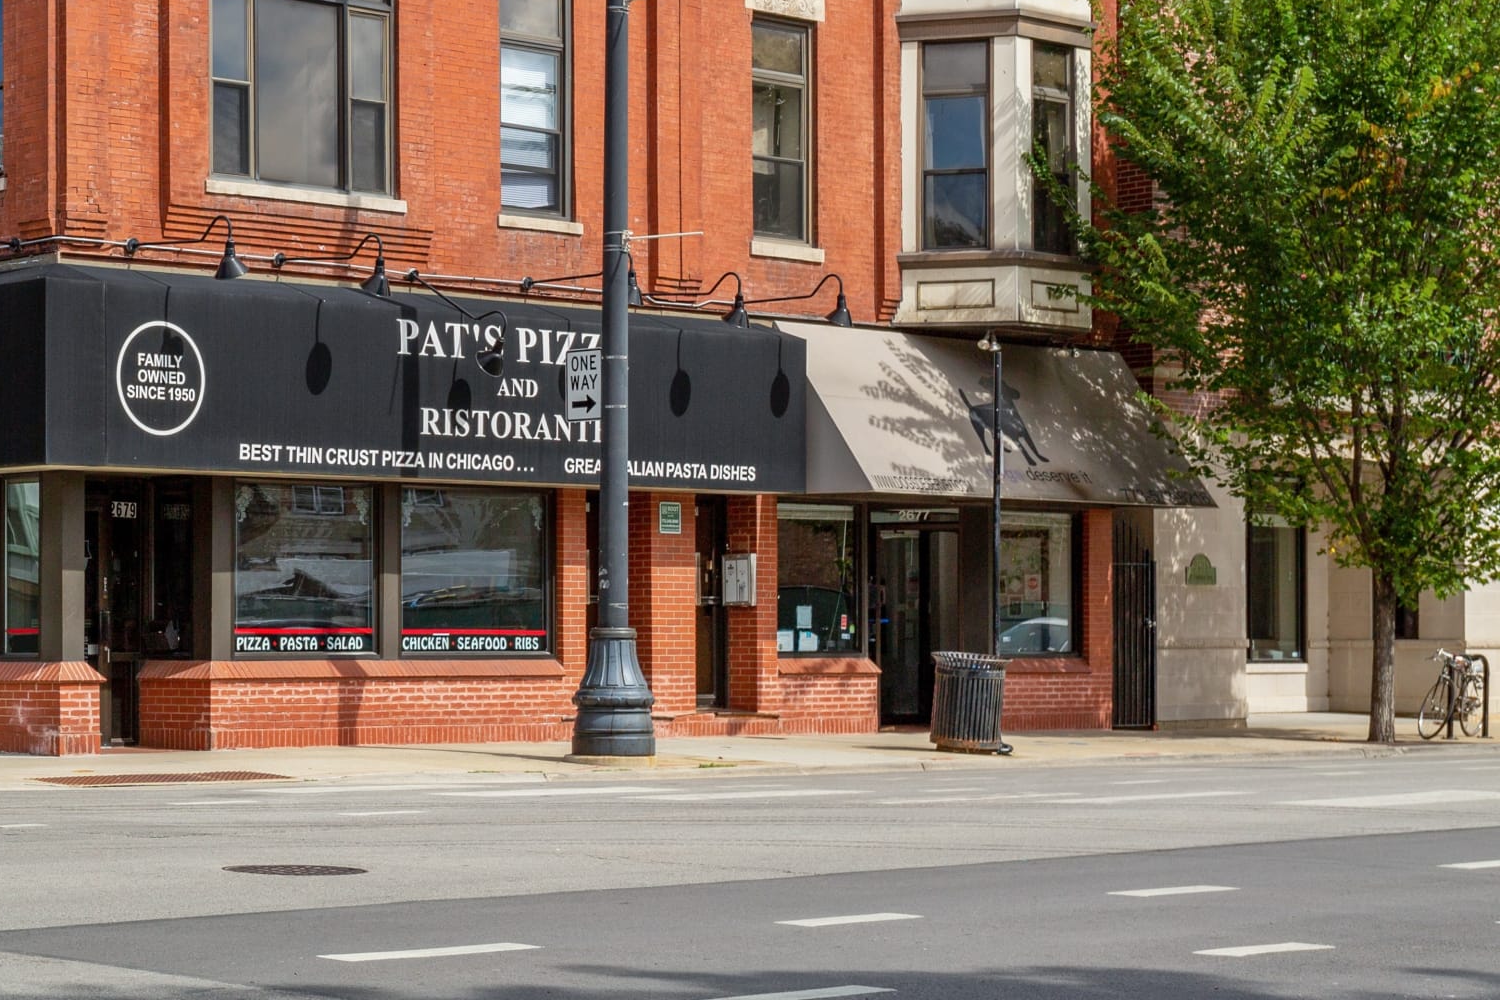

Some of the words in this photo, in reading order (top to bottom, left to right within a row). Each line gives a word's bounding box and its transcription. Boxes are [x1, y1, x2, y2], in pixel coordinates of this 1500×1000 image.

[396, 318, 505, 360] PAT'S
[515, 327, 601, 365] PIZ
[137, 352, 183, 369] FAMILY
[571, 354, 597, 371] ONE
[137, 368, 186, 385] OWNED
[570, 374, 598, 391] WAY
[126, 384, 166, 400] SINCE
[167, 387, 196, 402] 1950
[496, 378, 539, 398] AND
[239, 443, 283, 461] BEST
[286, 446, 323, 464] THIN
[325, 448, 379, 466] CRUST
[382, 450, 425, 468] PIZZA
[428, 452, 443, 469] IN
[564, 456, 601, 475] GREA
[627, 460, 664, 478] ALIAN
[666, 463, 708, 480] PASTA
[710, 464, 756, 482] DISHES
[1026, 466, 1080, 483] deserve
[111, 502, 136, 518] 2679
[898, 509, 931, 521] 2677
[236, 636, 271, 651] PIZZA
[280, 637, 318, 651] PASTA
[326, 637, 363, 650] SALAD
[402, 636, 450, 650] CHICKEN
[457, 636, 508, 650] SEAFOOD
[515, 637, 539, 650] RIBS
